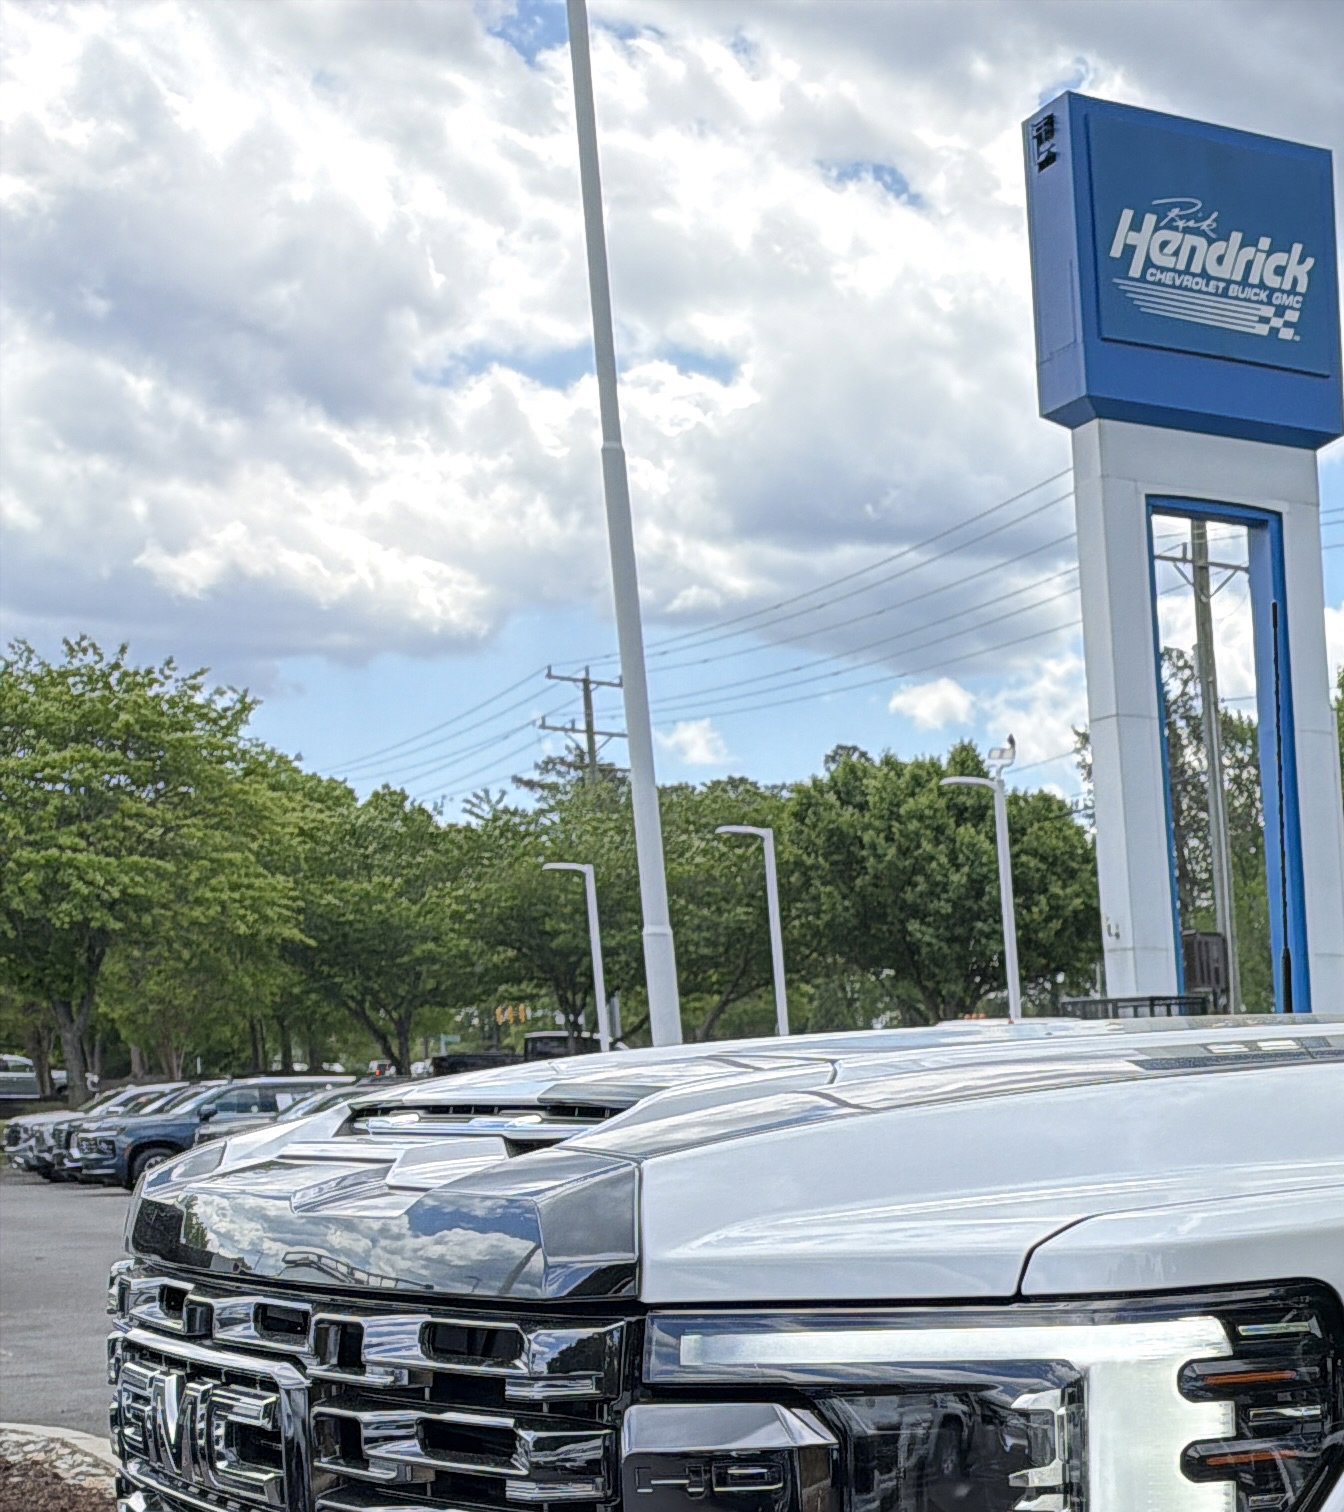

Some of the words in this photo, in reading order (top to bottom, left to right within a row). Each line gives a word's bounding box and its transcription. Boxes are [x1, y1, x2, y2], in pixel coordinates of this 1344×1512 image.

[1109, 208, 1315, 294] Hendrick
[1145, 267, 1226, 297] CHEVROLET
[1228, 283, 1269, 303] BUICK
[1272, 292, 1303, 309] GMC
